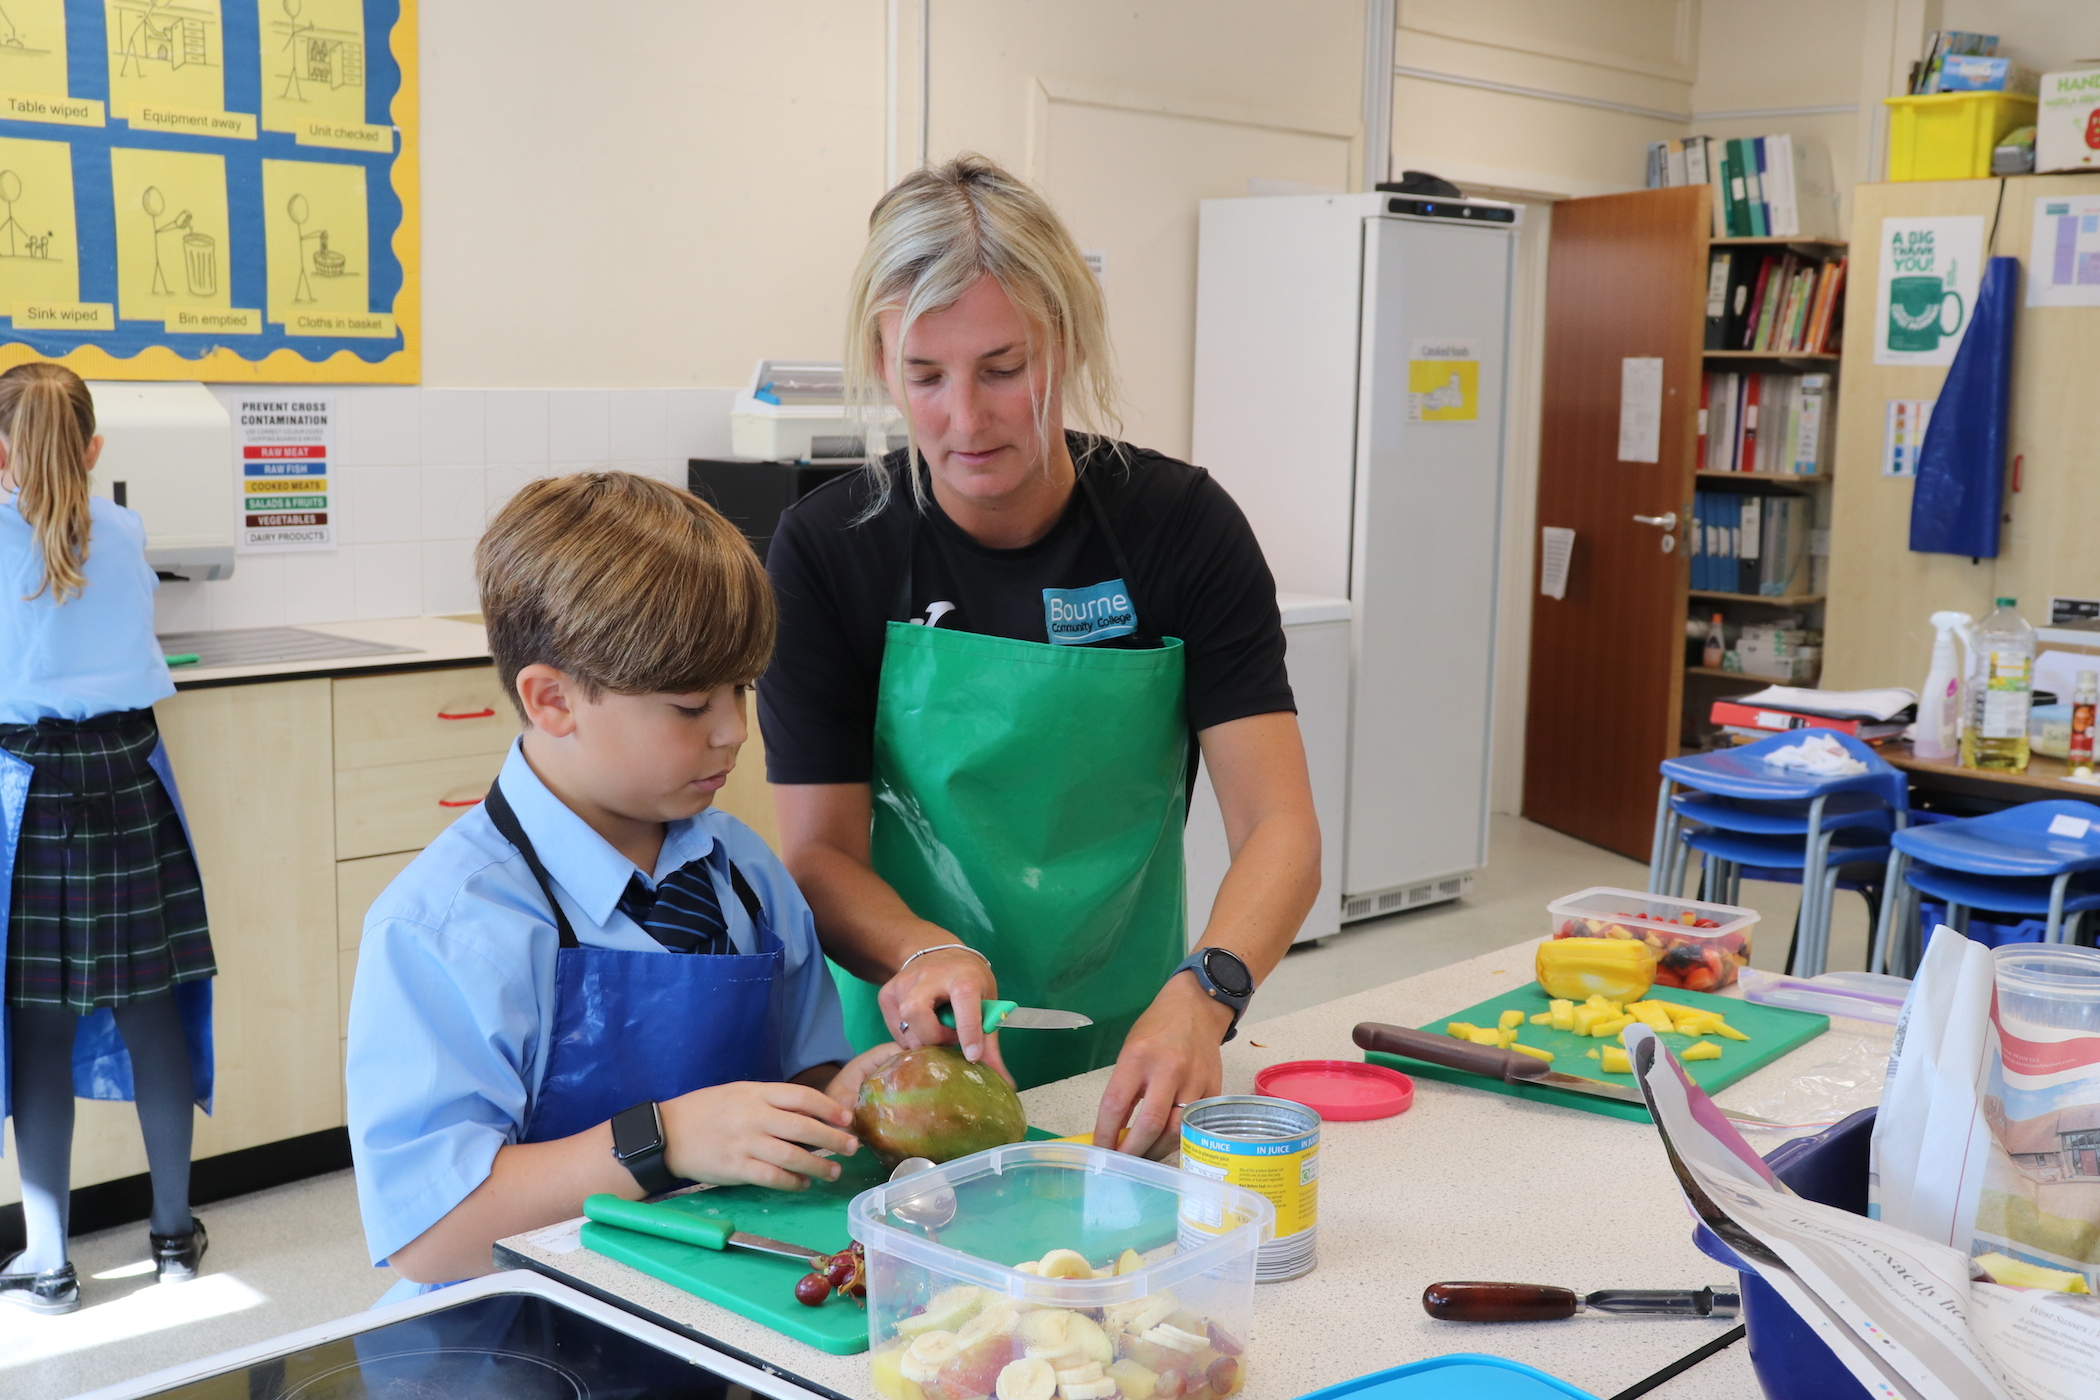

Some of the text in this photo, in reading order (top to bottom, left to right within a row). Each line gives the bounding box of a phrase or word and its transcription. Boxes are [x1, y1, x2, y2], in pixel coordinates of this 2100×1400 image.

[8, 98, 88, 119] Table wiped
[143, 109, 242, 132] Equipment away
[309, 125, 379, 142] Unit checked
[1892, 230, 1935, 244] A BIG
[1893, 246, 1935, 256] THANK
[1894, 258, 1935, 272] YOU!
[28, 307, 98, 324] Sink wiped
[179, 312, 247, 329] Bin emptied
[298, 317, 383, 331] Cloths in basket
[242, 402, 326, 412] PREVENT CROSS
[241, 415, 328, 426] CONTAMINATION
[261, 447, 310, 457] RAW MEAT
[264, 464, 307, 474] RAW FISH
[251, 481, 320, 491] COOKED MEATS
[249, 498, 324, 509] SALADS & FRUITS
[258, 515, 316, 526] VEGETABLES
[250, 531, 324, 542] DAIRY PRODUCTS
[1050, 594, 1129, 621] Bourne
[1052, 613, 1132, 633] Community College
[1201, 1138, 1209, 1147] IN
[1209, 1141, 1231, 1152] JUICE
[1257, 1146, 1266, 1154] IN
[1268, 1145, 1290, 1155] JUICE
[1301, 1139, 1310, 1149] IN
[1872, 1248, 1941, 1299] exactly
[1871, 1267, 1893, 1288] always
[1891, 1288, 1906, 1298] put
[1903, 1297, 1921, 1309] your
[1919, 1308, 1941, 1325] needs
[1991, 1293, 2012, 1304] price)
[2030, 1305, 2054, 1320] West
[2054, 1315, 2089, 1334] Sussex
[2025, 1320, 2058, 1336] charming
[2012, 1323, 2096, 1359] well-presented gardens.
